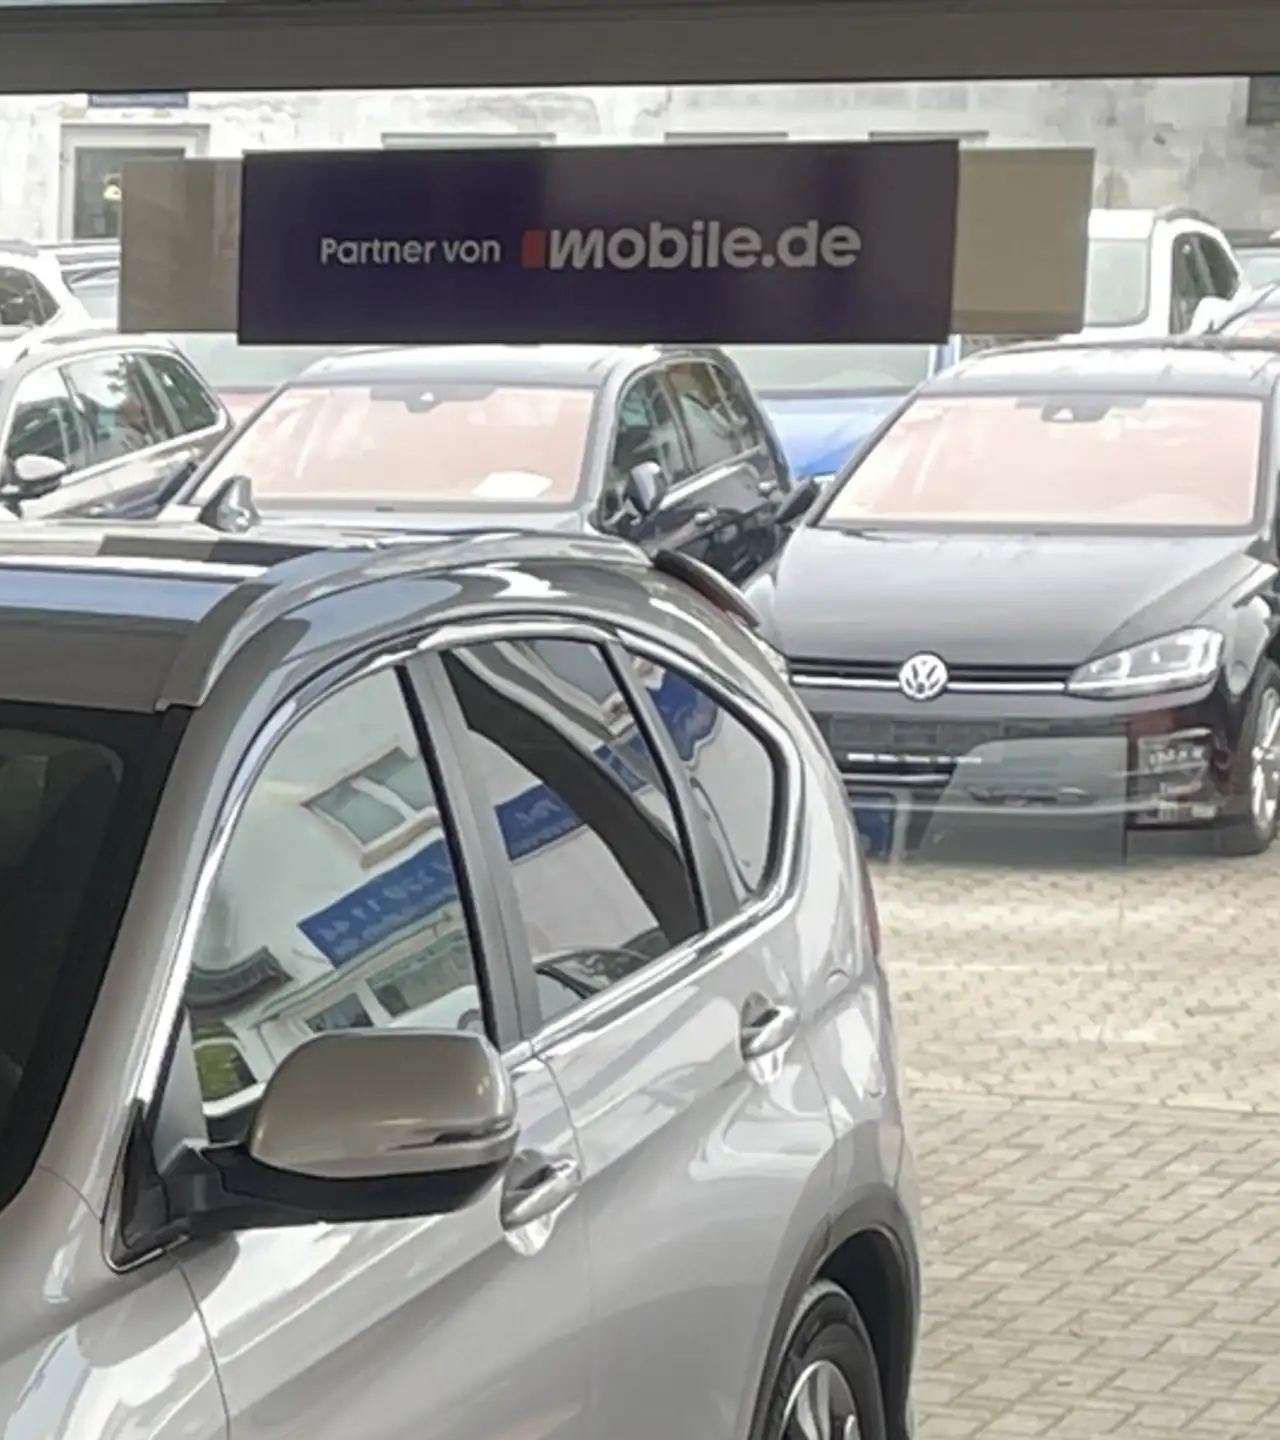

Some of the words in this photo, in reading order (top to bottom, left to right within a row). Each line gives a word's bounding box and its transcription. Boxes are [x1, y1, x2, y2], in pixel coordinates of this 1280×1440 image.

[320, 236, 437, 265] Partner
[442, 239, 501, 264] von
[548, 219, 862, 270] mobile.de
